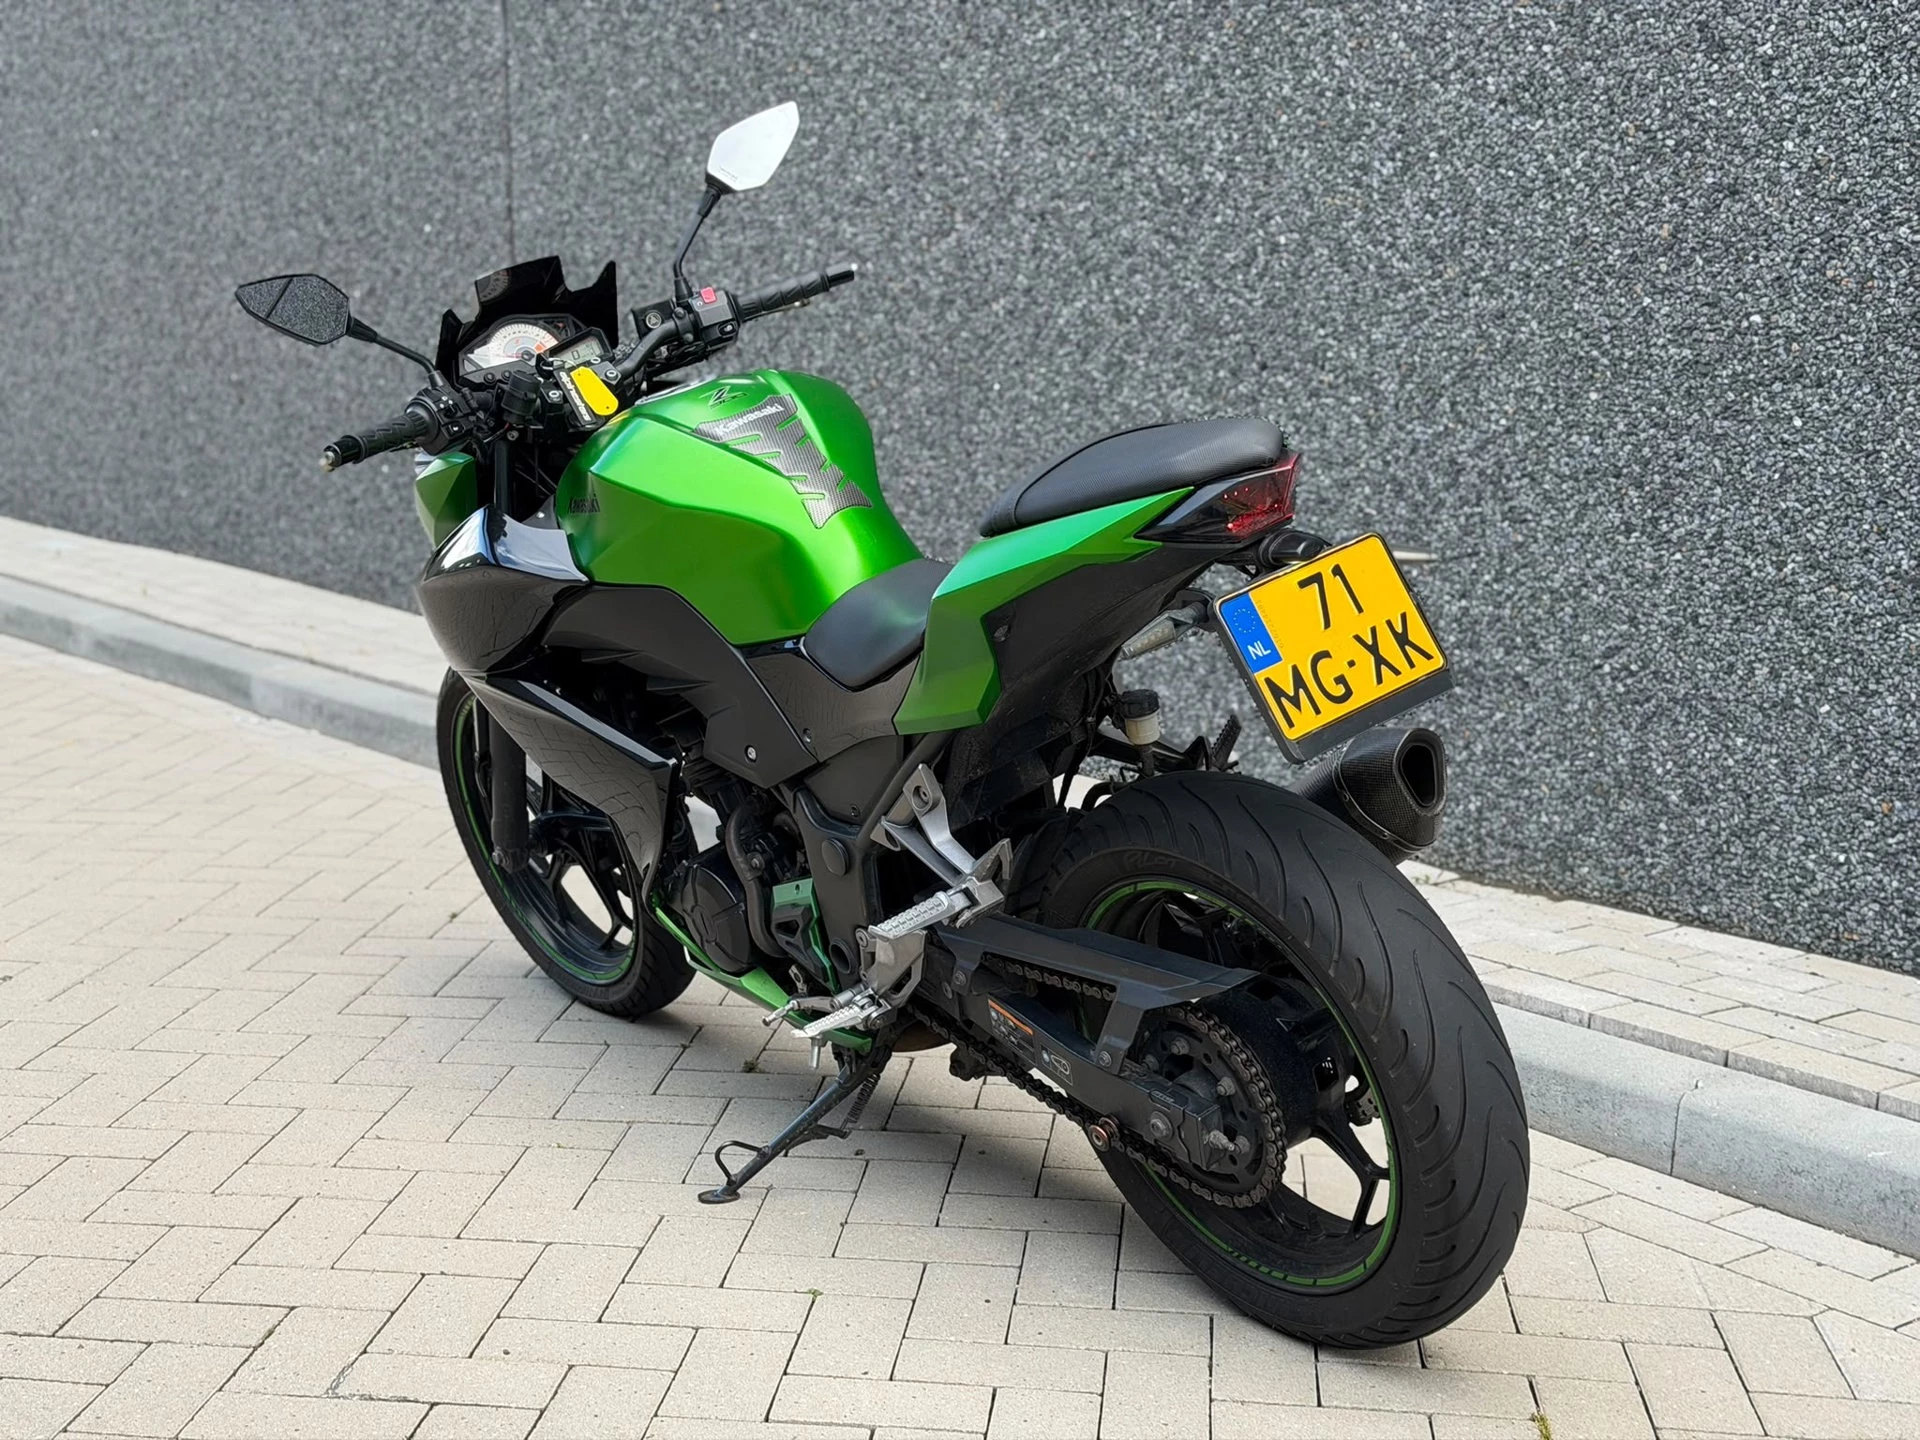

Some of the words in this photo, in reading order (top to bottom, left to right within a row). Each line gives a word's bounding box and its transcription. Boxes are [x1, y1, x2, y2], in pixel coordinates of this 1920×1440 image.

[714, 402, 785, 437] Kawasaki
[1296, 563, 1364, 630] 71
[1247, 640, 1271, 660] NL
